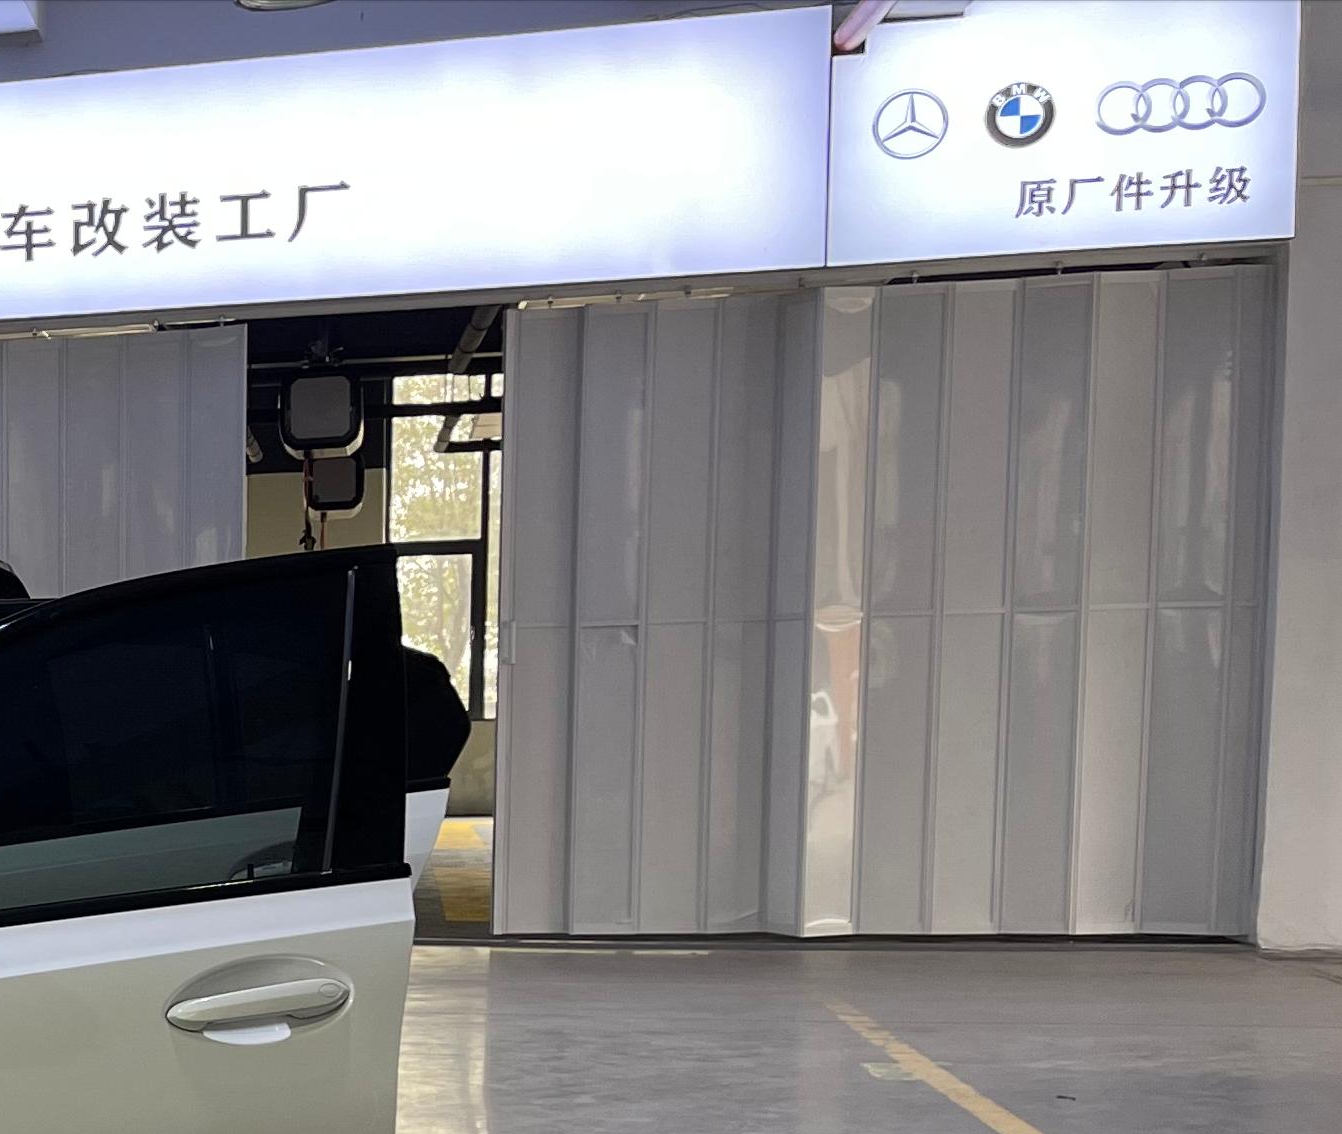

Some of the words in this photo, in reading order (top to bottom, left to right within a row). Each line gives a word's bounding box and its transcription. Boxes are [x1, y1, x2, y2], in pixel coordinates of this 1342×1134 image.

[992, 83, 1051, 107] BMW
[1015, 166, 1251, 218] 原厂件升级
